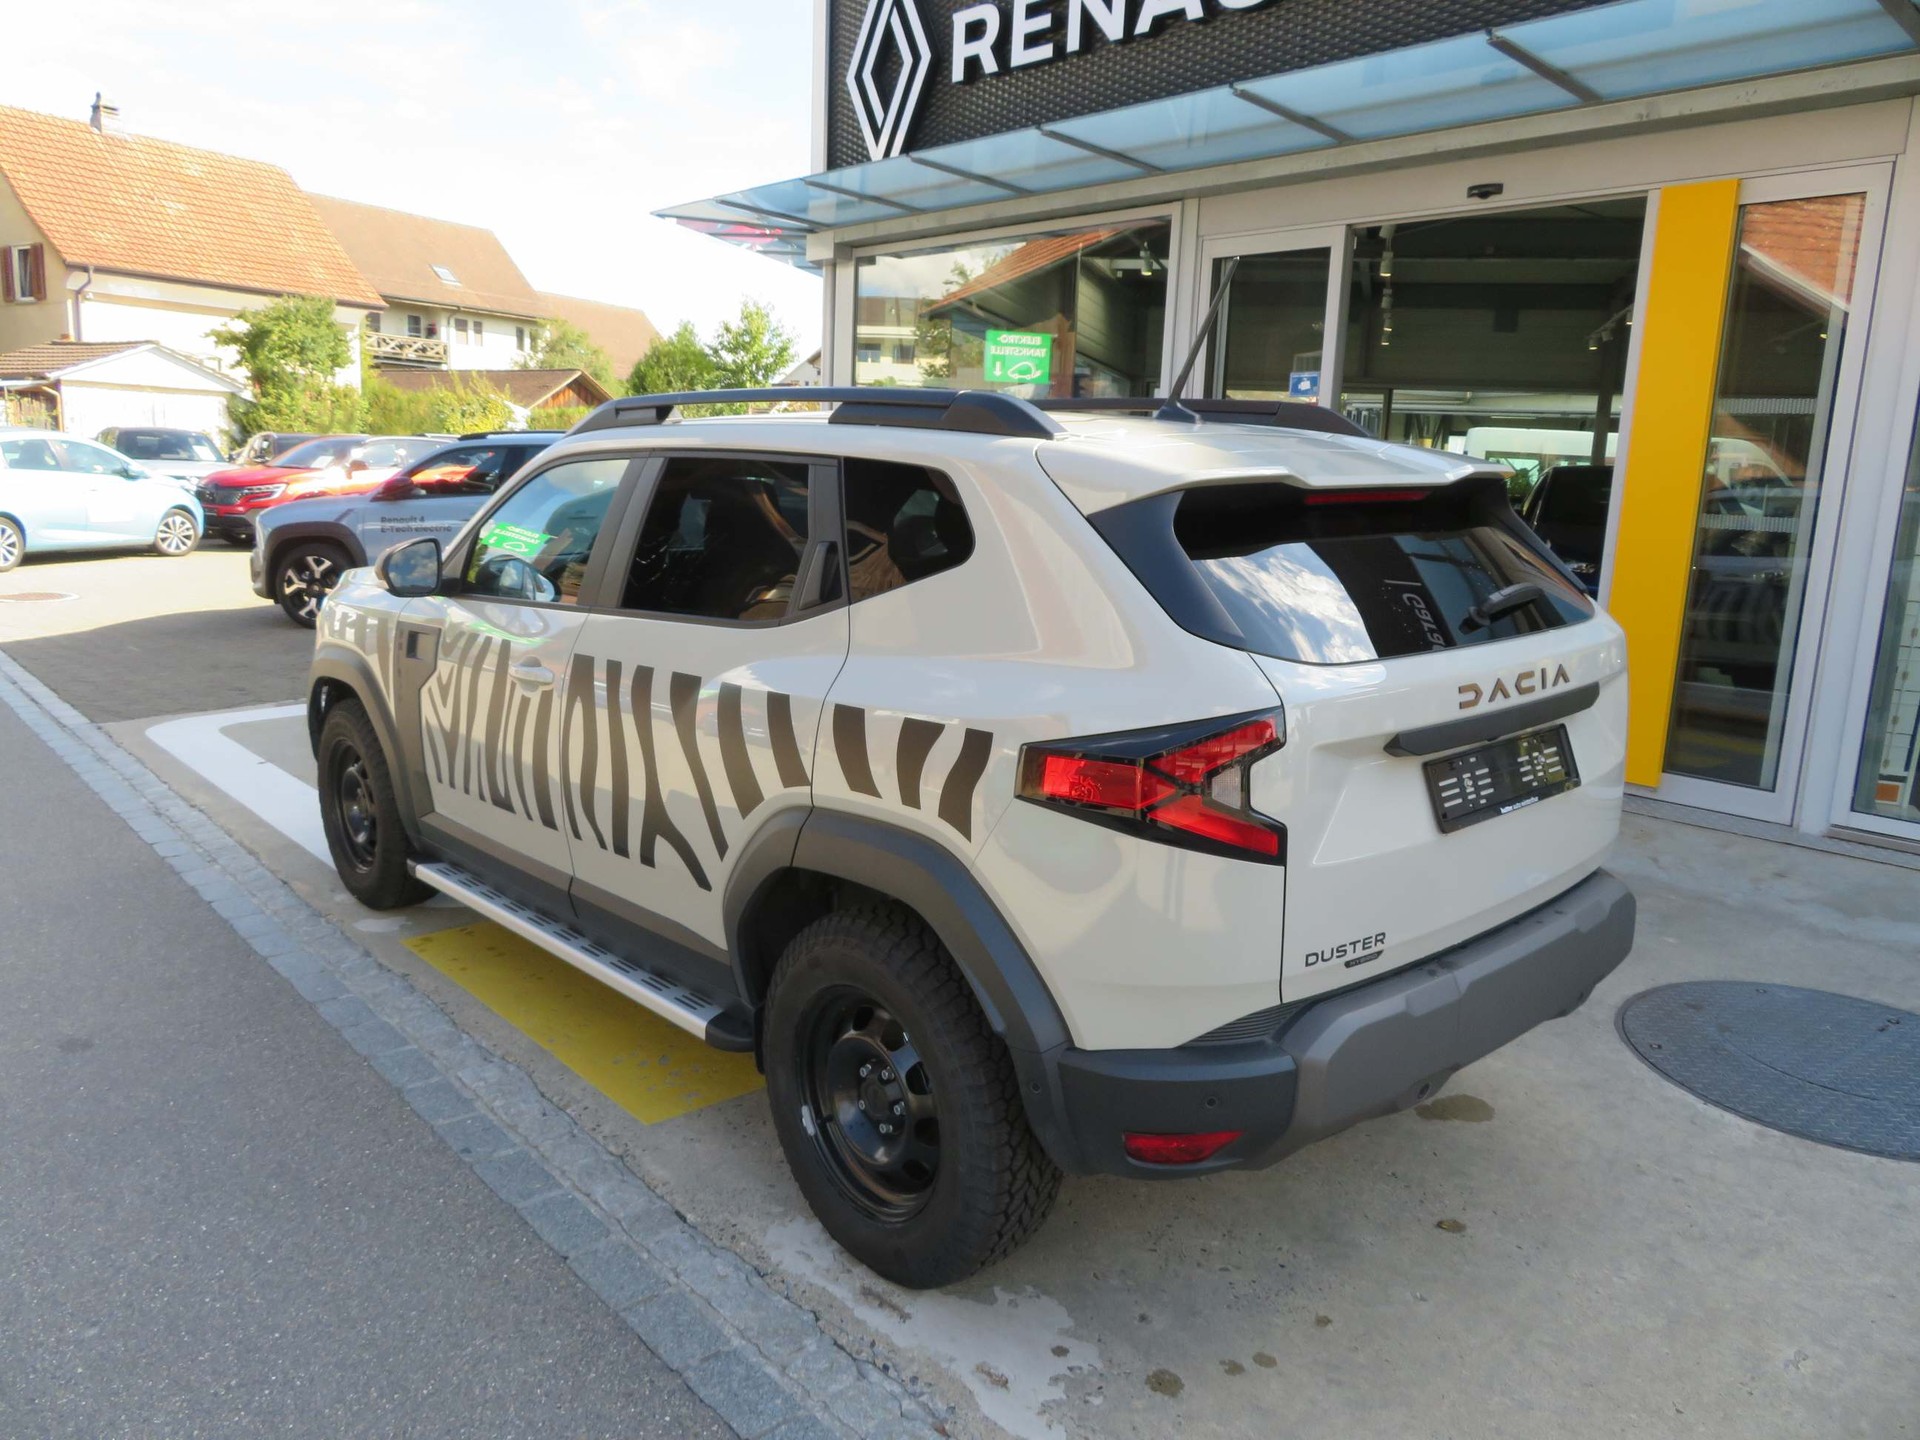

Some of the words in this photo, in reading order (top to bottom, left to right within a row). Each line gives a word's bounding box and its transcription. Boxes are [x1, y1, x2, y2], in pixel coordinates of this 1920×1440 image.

[952, 0, 1263, 83] REN
[380, 515, 417, 523] Renault
[1458, 663, 1571, 710] DACIA
[1304, 931, 1386, 968] DUSTER
